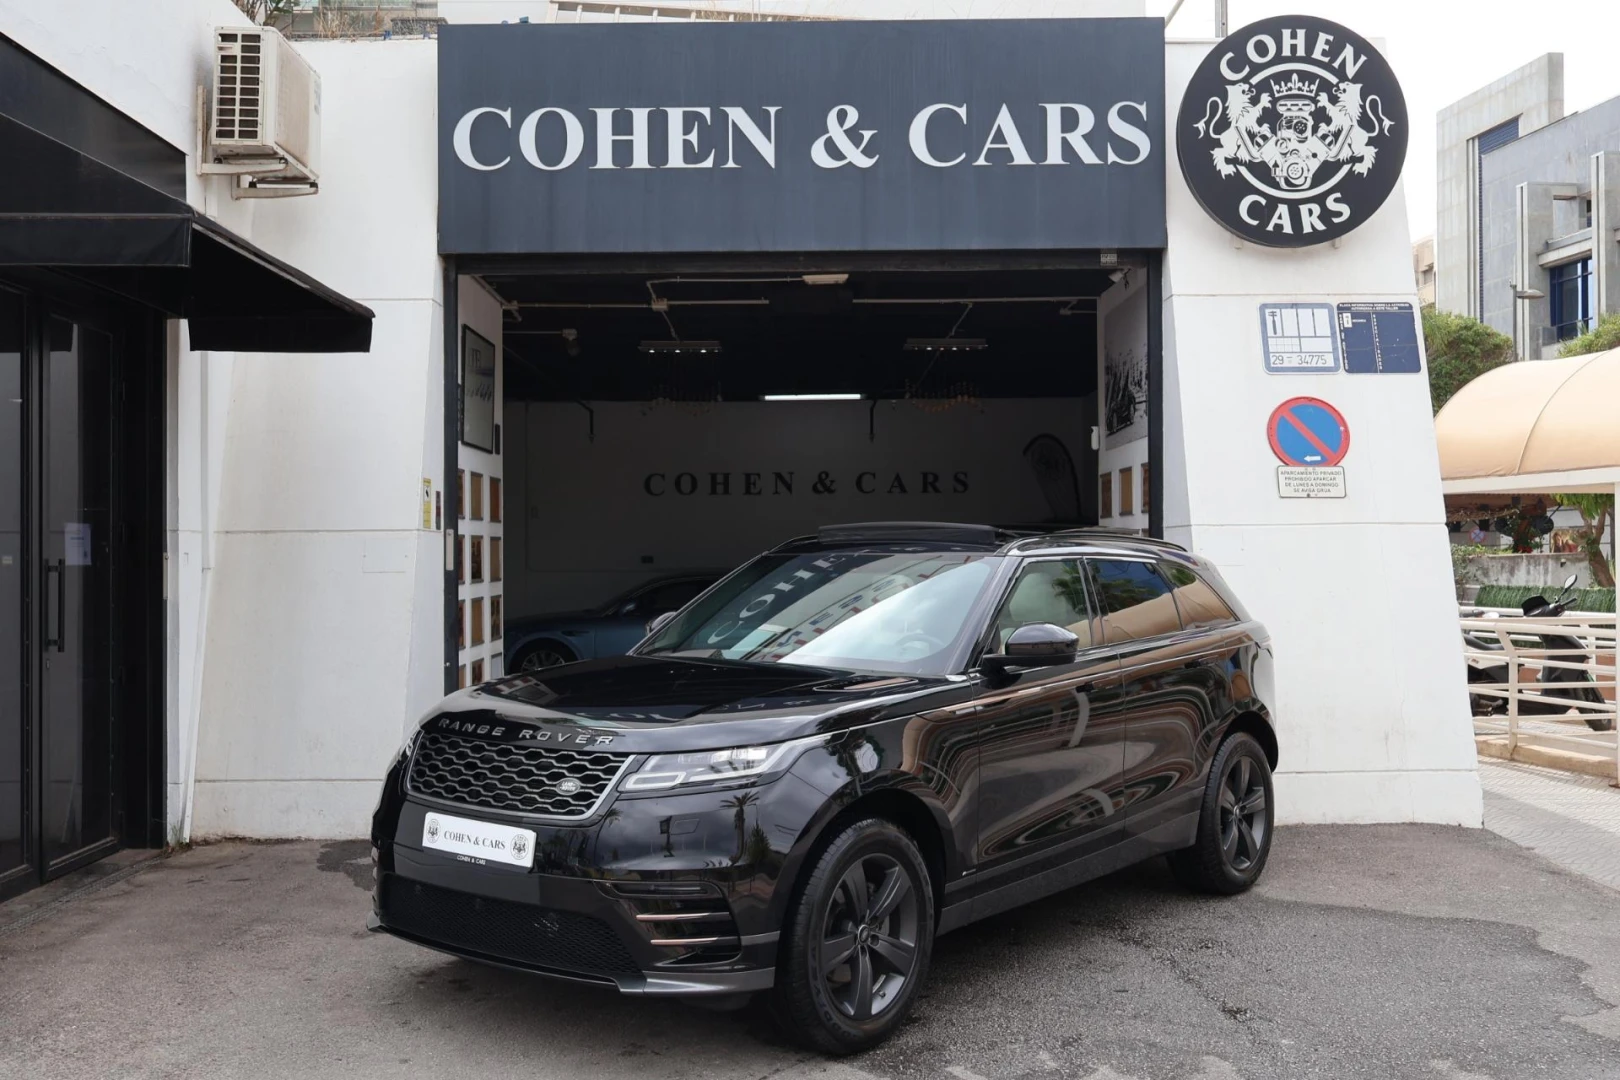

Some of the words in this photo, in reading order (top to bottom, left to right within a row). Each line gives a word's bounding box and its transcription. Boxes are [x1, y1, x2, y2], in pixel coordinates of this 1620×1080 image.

[1219, 28, 1368, 82] COHEN
[452, 105, 783, 171] COHEN
[810, 103, 880, 169] &
[908, 100, 1151, 168] CARS
[1238, 192, 1351, 235] CARS
[1272, 354, 1284, 365] 29
[1297, 354, 1327, 365] 34775
[643, 471, 795, 497] COHEN
[811, 471, 837, 495] &
[855, 471, 970, 494] CARS
[438, 718, 505, 737] RANGE
[519, 729, 614, 746] ROVER
[444, 830, 472, 843] COHEN
[473, 837, 480, 846] &
[482, 838, 506, 850] CARS
